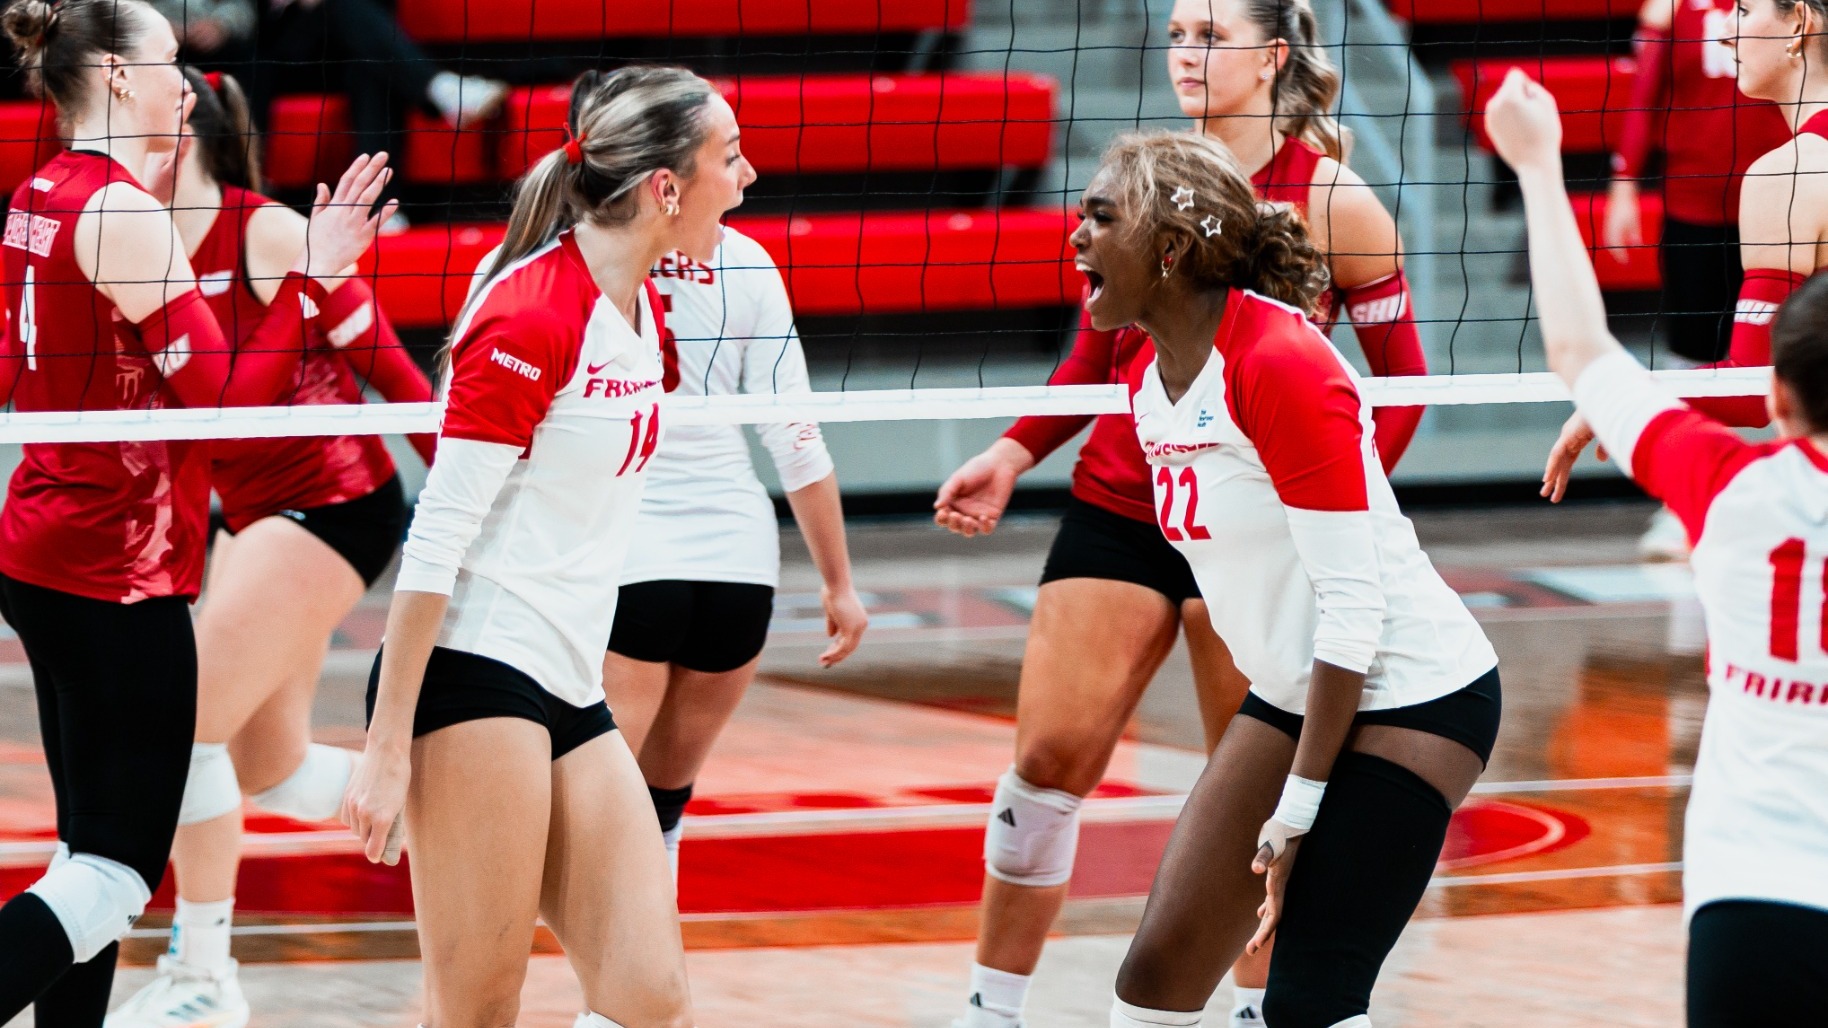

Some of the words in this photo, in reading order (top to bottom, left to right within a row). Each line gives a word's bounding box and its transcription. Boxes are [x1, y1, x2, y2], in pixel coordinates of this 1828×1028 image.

[1351, 291, 1407, 328] SHU
[490, 347, 542, 382] METRO
[1156, 466, 1213, 541] 22
